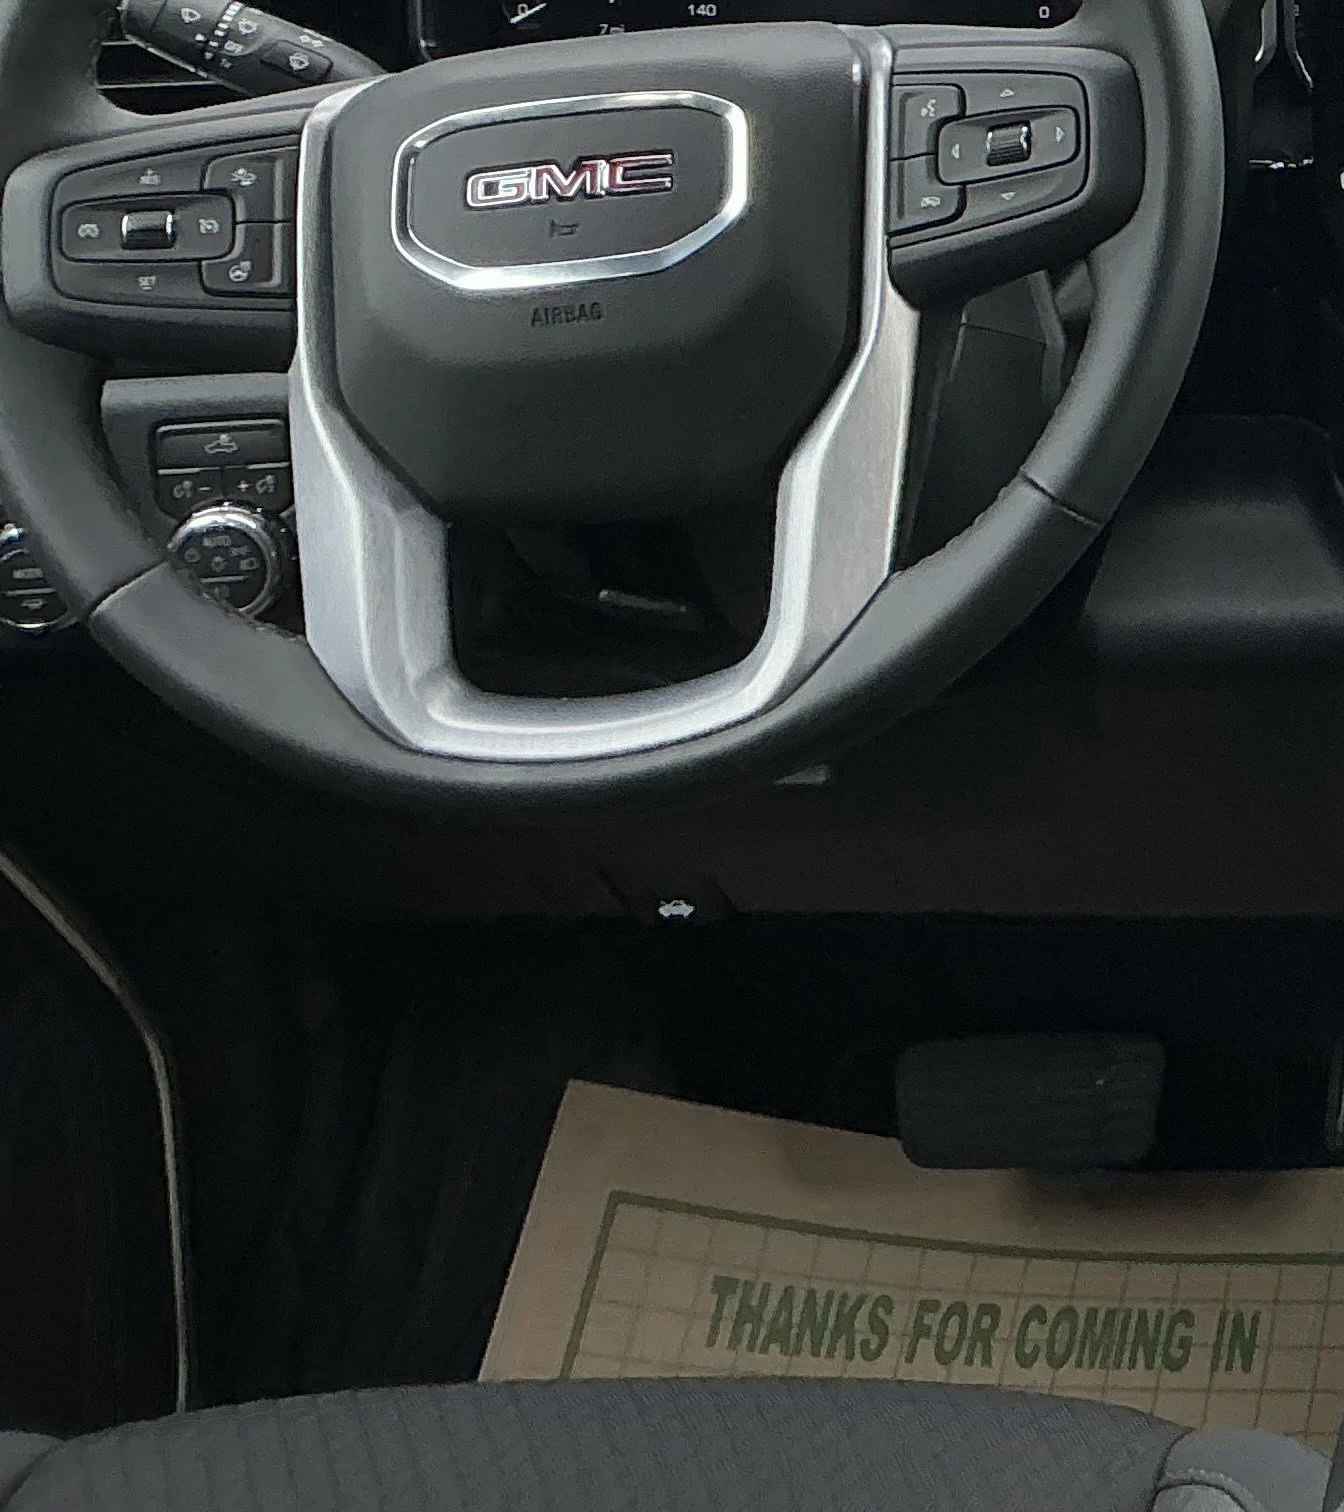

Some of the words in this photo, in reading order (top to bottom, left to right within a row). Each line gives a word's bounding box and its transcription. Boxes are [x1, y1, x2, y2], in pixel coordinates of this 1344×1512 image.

[687, 3, 718, 17] 140
[1038, 5, 1050, 19] 0
[465, 149, 674, 211] GMC
[531, 302, 603, 327] AIRBAG
[704, 1275, 895, 1363] THANKS
[904, 1298, 1000, 1367] FOR
[1013, 1304, 1195, 1373] COMING
[1209, 1308, 1261, 1374] IN
